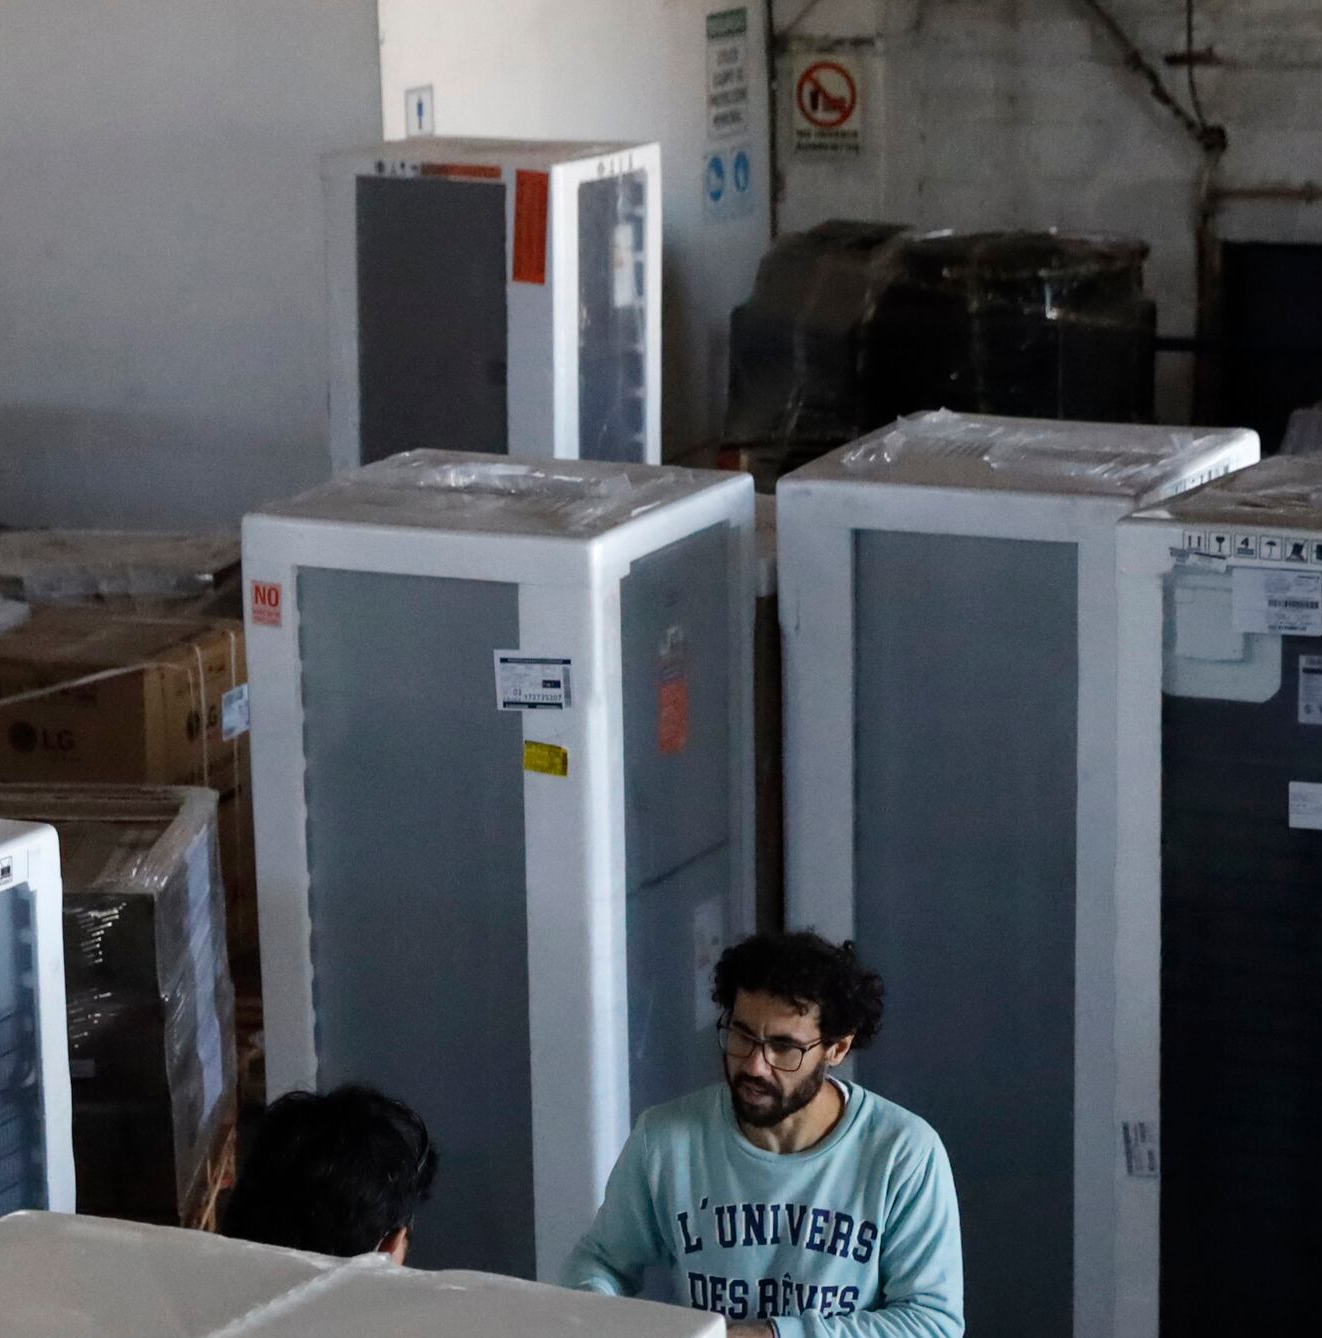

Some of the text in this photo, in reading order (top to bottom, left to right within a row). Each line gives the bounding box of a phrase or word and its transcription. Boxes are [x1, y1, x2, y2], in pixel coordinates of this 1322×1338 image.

[254, 585, 279, 608] NO
[42, 729, 75, 751] LG
[688, 1272, 749, 1320] DES
